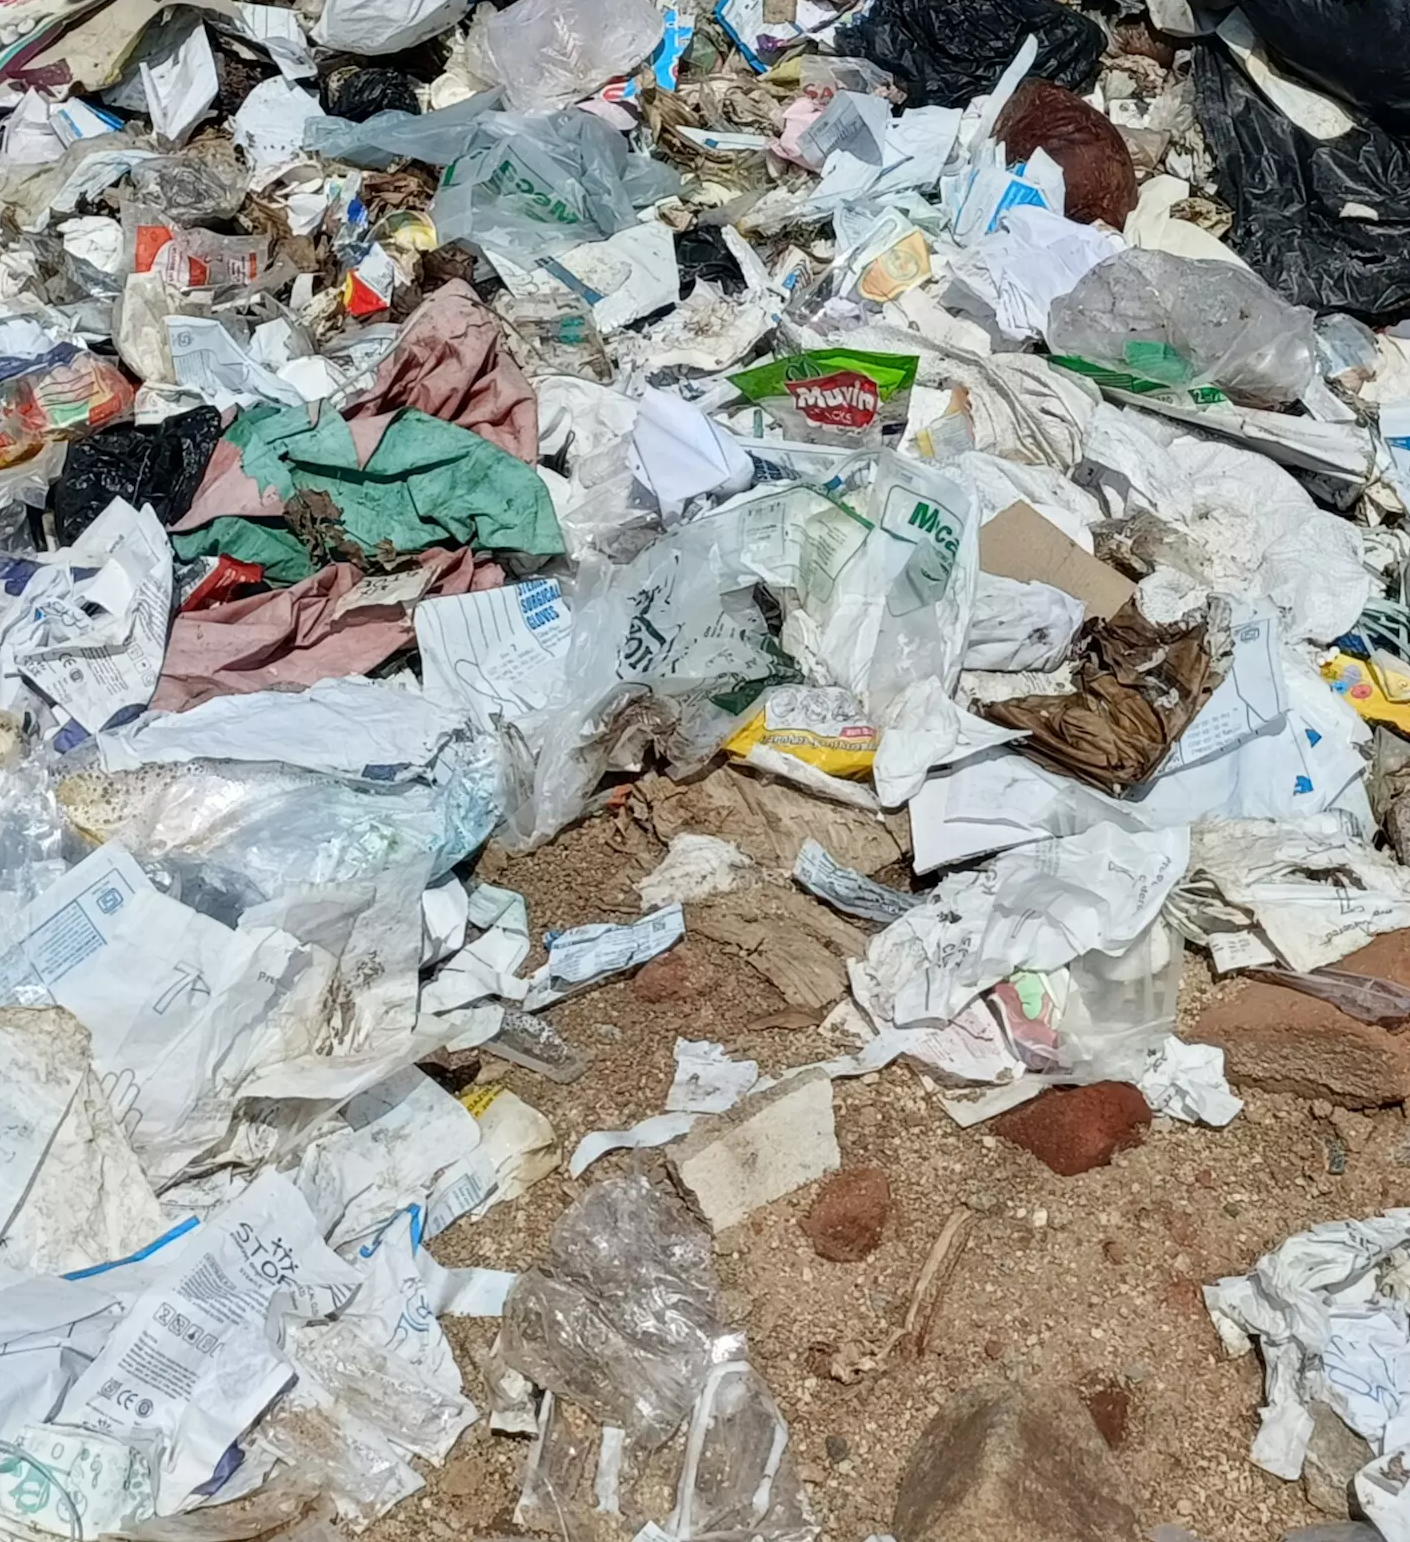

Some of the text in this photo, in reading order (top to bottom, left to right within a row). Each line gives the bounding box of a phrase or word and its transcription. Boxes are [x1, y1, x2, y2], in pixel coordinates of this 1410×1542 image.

[796, 379, 875, 411] Muvin
[520, 584, 562, 614] SURGICAL
[526, 605, 560, 630] GLOVES
